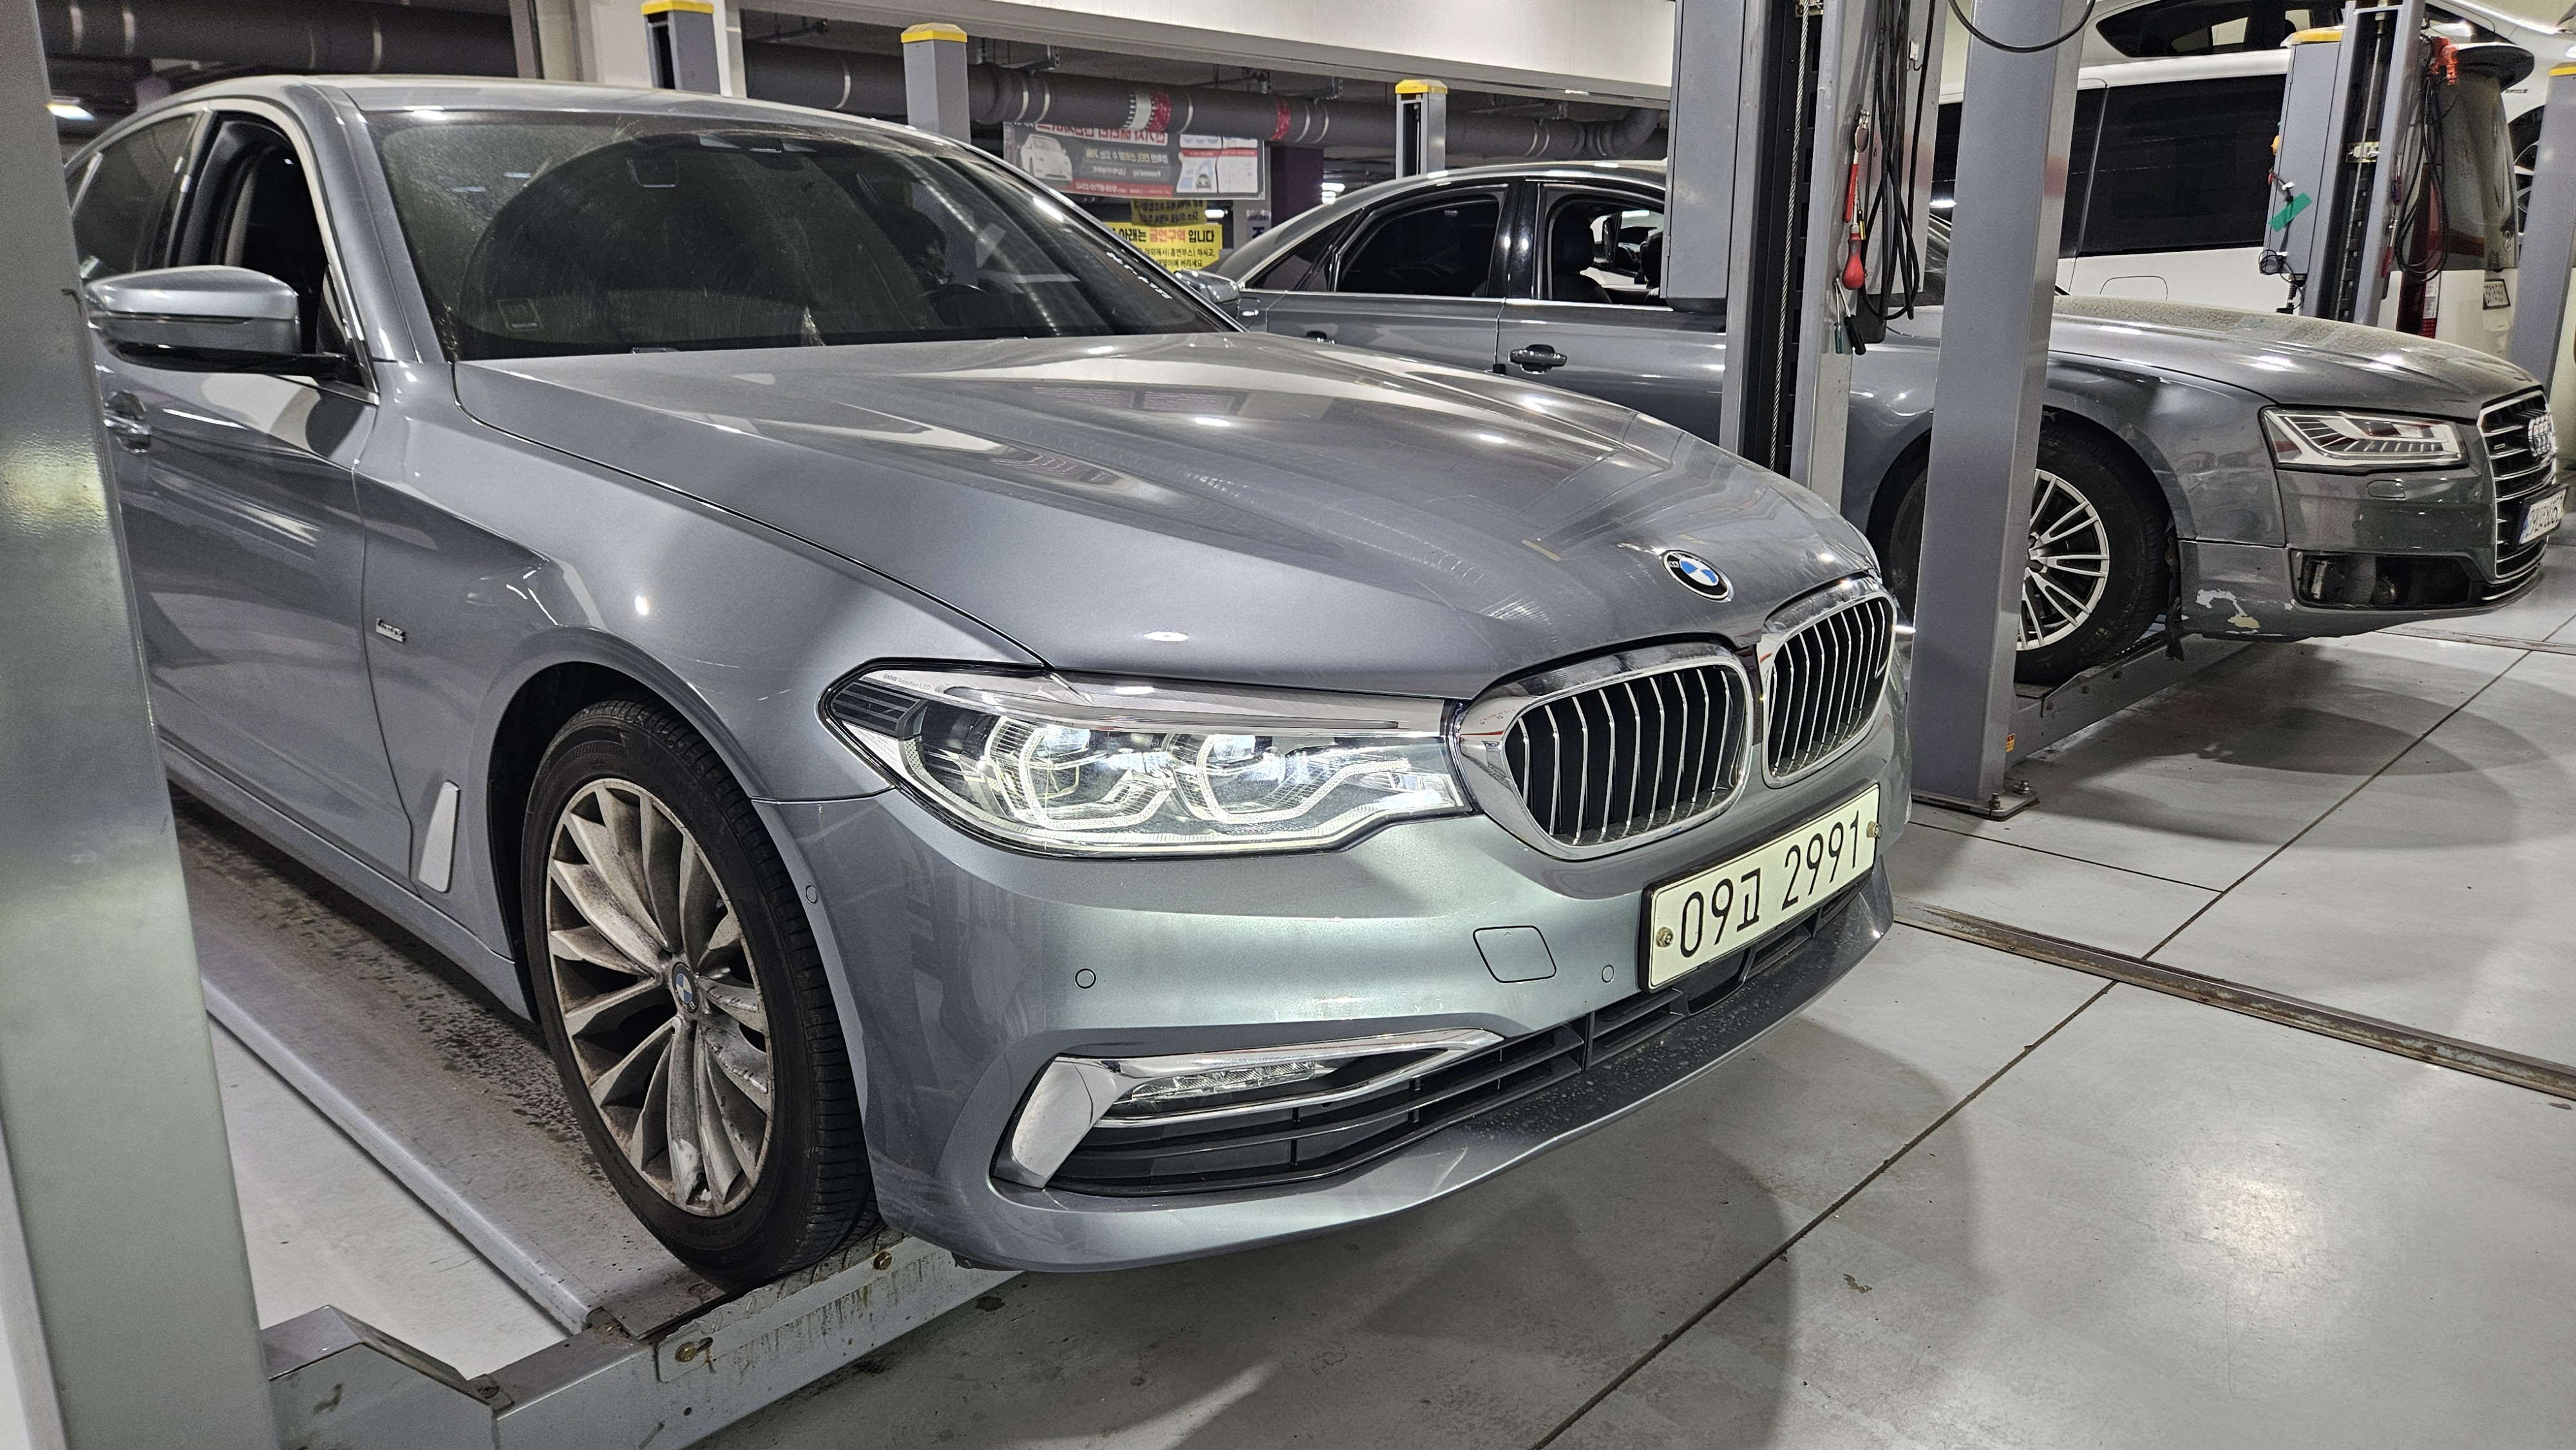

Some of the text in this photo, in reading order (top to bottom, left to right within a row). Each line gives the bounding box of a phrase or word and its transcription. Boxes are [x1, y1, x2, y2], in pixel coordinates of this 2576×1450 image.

[1119, 227, 1215, 243] 아래는 금연구역 입니다
[883, 673, 898, 682] BMW
[898, 678, 919, 688] Adaptive
[1680, 810, 1860, 958] 09교 2991
